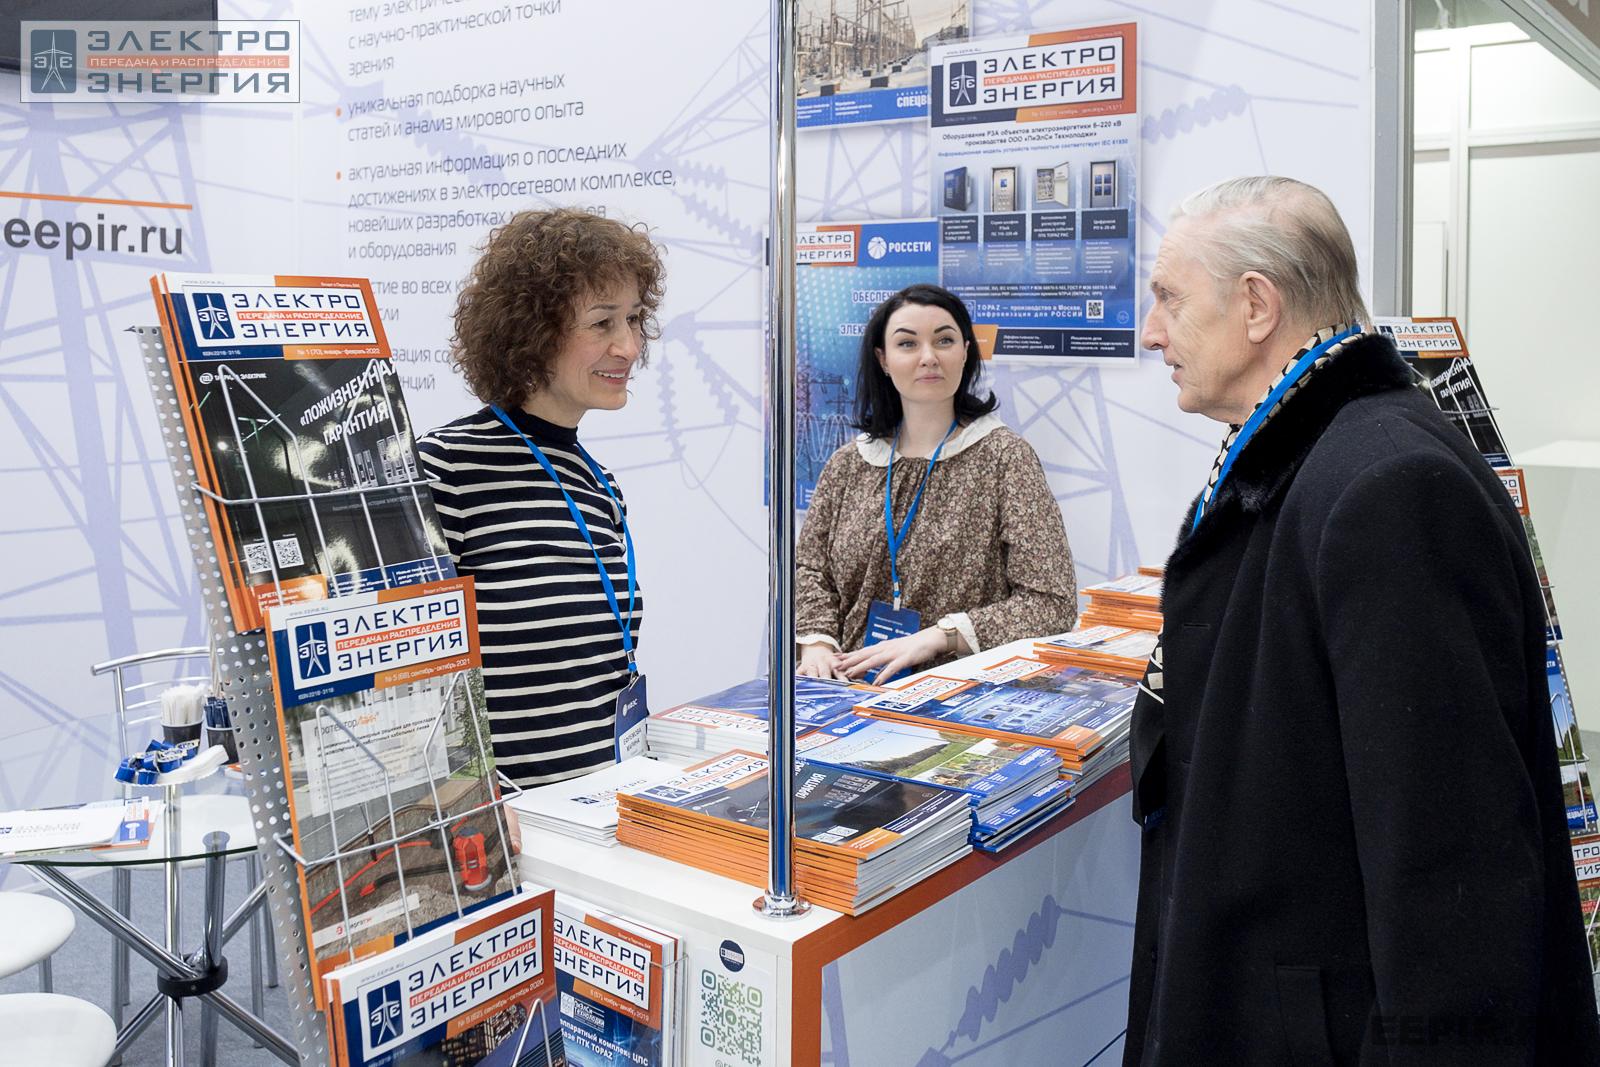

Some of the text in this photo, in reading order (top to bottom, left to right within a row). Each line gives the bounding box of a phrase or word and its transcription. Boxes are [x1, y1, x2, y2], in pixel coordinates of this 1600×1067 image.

[515, 0, 562, 20] точки
[348, 56, 394, 77] зрения
[984, 46, 1115, 73] ЭЛЕКТРО
[985, 73, 1028, 86] ПЕРЕДАЧА
[1035, 66, 1112, 81] РАСПРЕДЕЛЕНИЕ
[349, 74, 565, 118] уникальная подборка научных
[984, 77, 1115, 103] ЭНЕРГИЯ
[348, 125, 391, 142] статей
[404, 118, 452, 136] анализ
[455, 107, 531, 131] мирового
[535, 100, 584, 122] опыта
[348, 143, 627, 181] актуальная информация о последних
[348, 167, 676, 208] достижениях в электросетевом комплексе,
[348, 214, 413, 233] новейших
[416, 211, 505, 233] разработках
[4, 214, 183, 260] eepir.ru
[798, 234, 851, 244] ЛЕКТРО
[888, 241, 932, 253] РОССЕТИ
[359, 240, 456, 261] оборудования
[798, 250, 851, 261] НЕРГИЯ
[233, 293, 360, 309] ЭЛЕКТРО
[853, 290, 896, 303] ОБЕСПЕЧ
[239, 312, 286, 320] ПЕРЕДАЧА
[293, 312, 362, 320] РАСПРЕДЕЛЕНИЕ
[242, 323, 369, 338] ЭНЕРГИЯ
[1395, 325, 1453, 334] ЭЛЕКТРО
[1400, 339, 1457, 348] ЭНЕРГИЯ
[333, 599, 460, 636] ЭЛЕКТРО
[337, 635, 382, 650] ПЕРЕДАЧА
[389, 620, 459, 639] РАСПРЕДЕЛЕНИЕ
[337, 631, 463, 672] ЭНЕРГИЯ
[409, 918, 536, 992] ЭЛЕКТРО
[554, 918, 646, 971] ЭЛЕКТРО
[411, 977, 457, 1006] ПЕРЕДАЧА
[465, 940, 535, 981] РАСПРЕДЕЛЕНИЕ
[554, 947, 645, 1001] ЭНЕРГИЯ
[589, 952, 645, 982] РАСПРЕДЕЛЕНИЕ
[411, 953, 537, 1029] ЭНЕРГИЯ
[591, 1043, 613, 1060] TOPAZ
